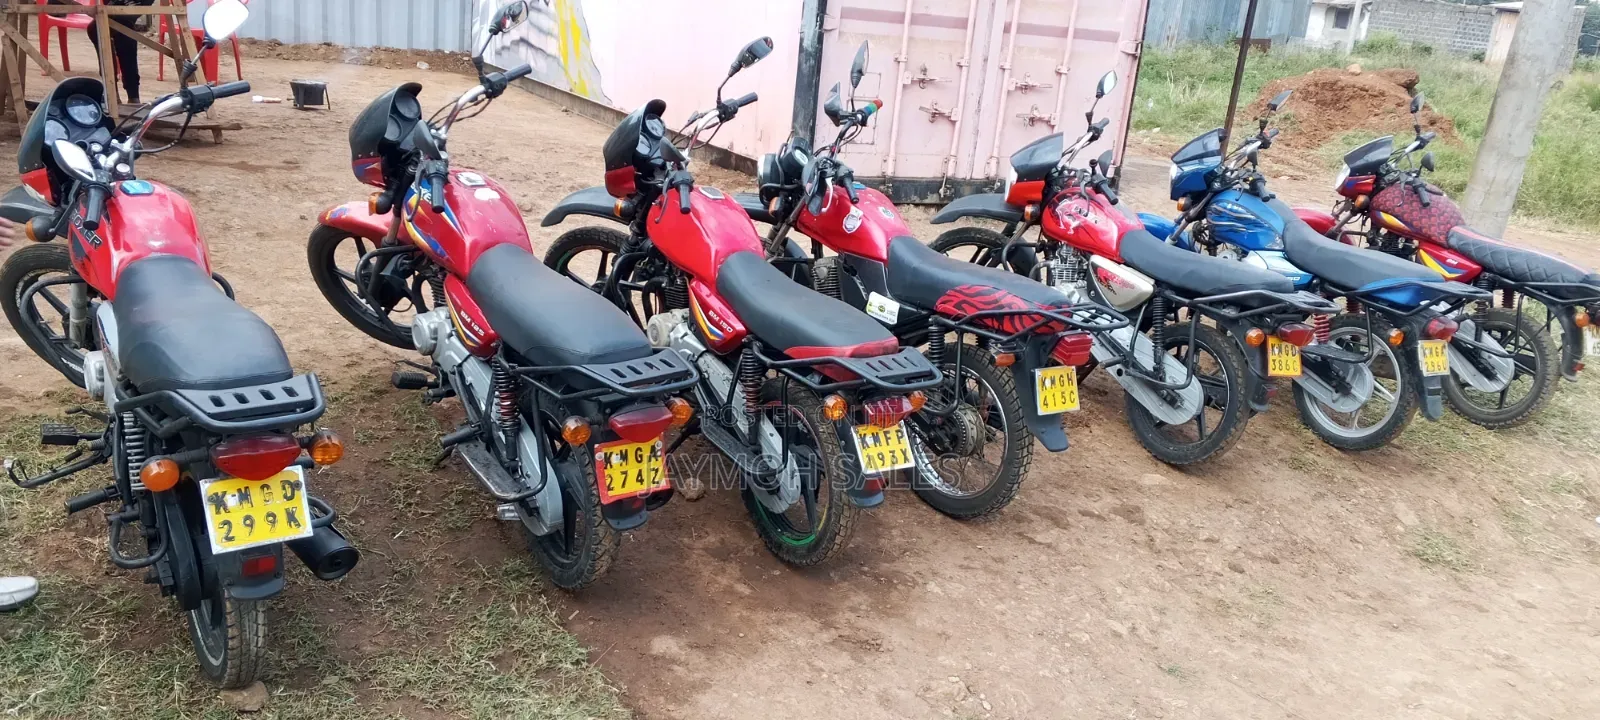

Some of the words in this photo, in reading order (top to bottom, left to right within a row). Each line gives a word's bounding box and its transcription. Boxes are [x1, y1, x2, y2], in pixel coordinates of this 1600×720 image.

[1043, 391, 1076, 408] 415C
[604, 467, 660, 491] 274Z
[218, 506, 302, 543] 299K
